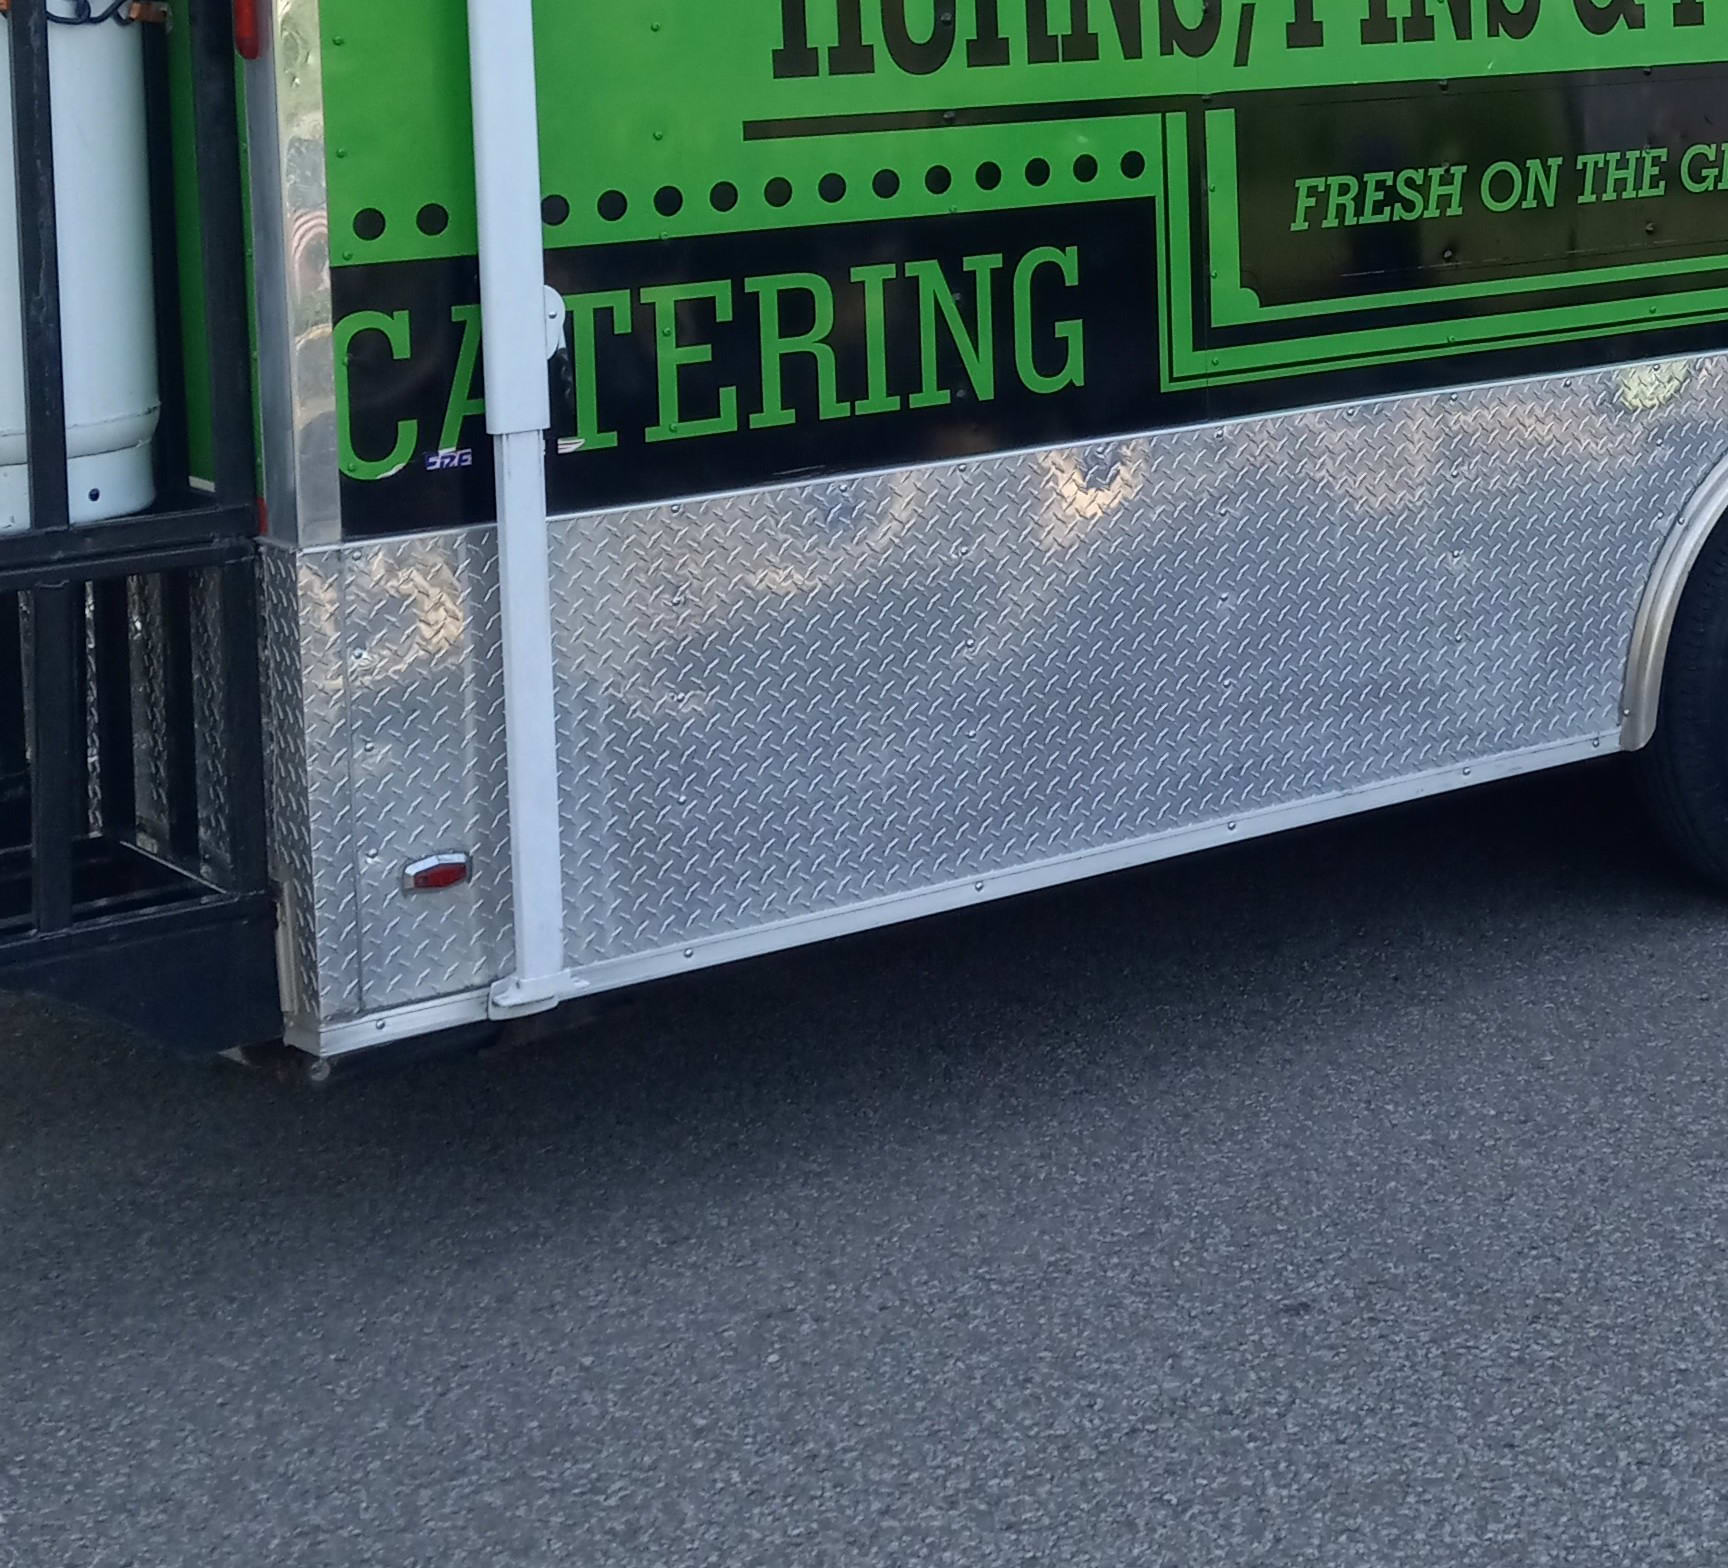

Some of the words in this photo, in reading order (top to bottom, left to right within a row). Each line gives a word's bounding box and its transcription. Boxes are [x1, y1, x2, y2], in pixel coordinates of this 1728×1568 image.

[1289, 163, 1469, 232] FRESH
[1480, 156, 1563, 212] ON
[1577, 146, 1666, 204] THE
